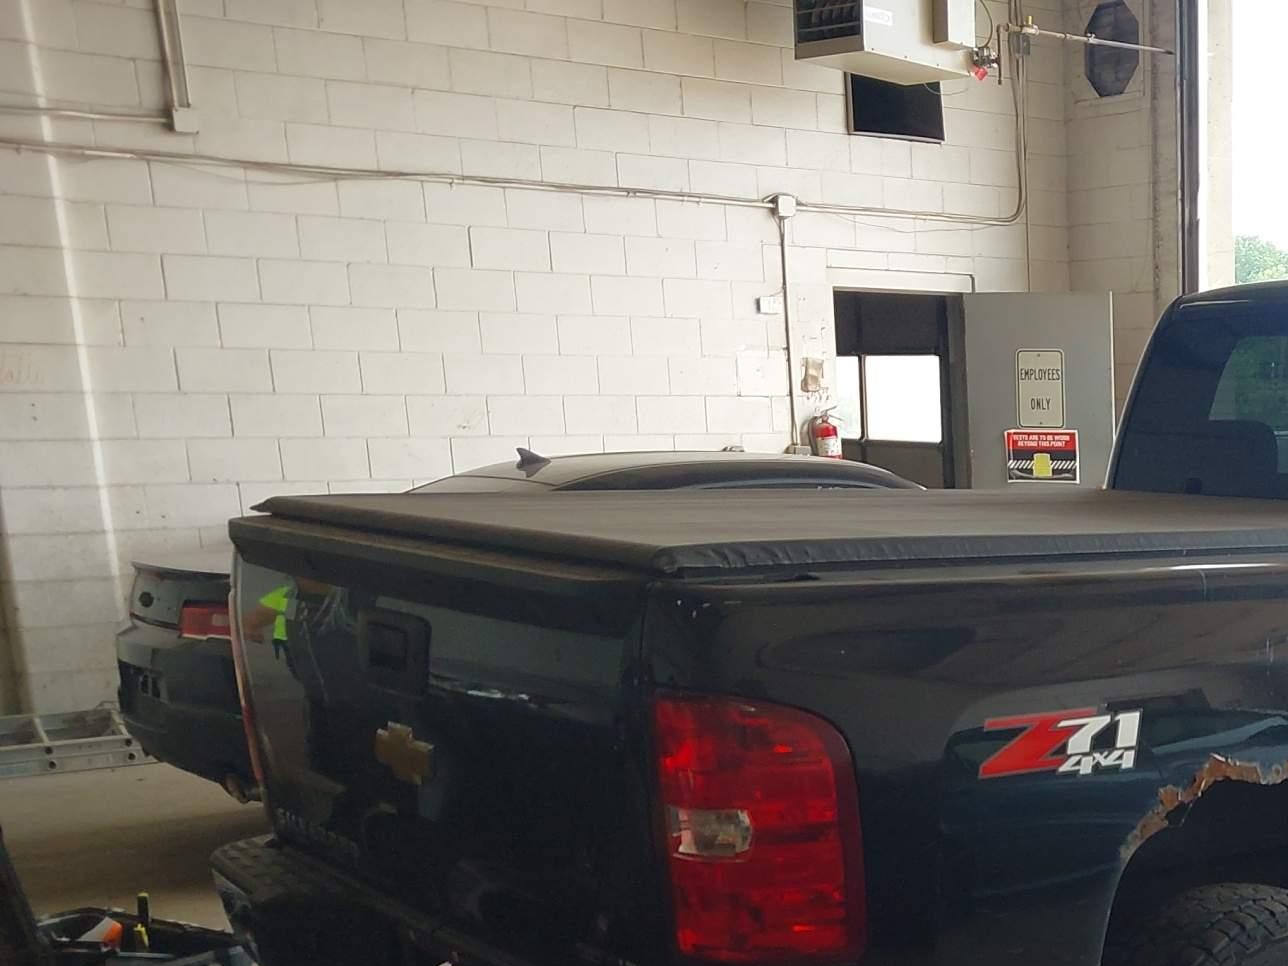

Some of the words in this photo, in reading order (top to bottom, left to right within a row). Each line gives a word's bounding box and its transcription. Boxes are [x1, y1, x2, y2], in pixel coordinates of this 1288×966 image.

[1020, 368, 1060, 381] EMPLOYEES
[1030, 398, 1051, 411] ONLY
[978, 706, 1142, 779] Z71
